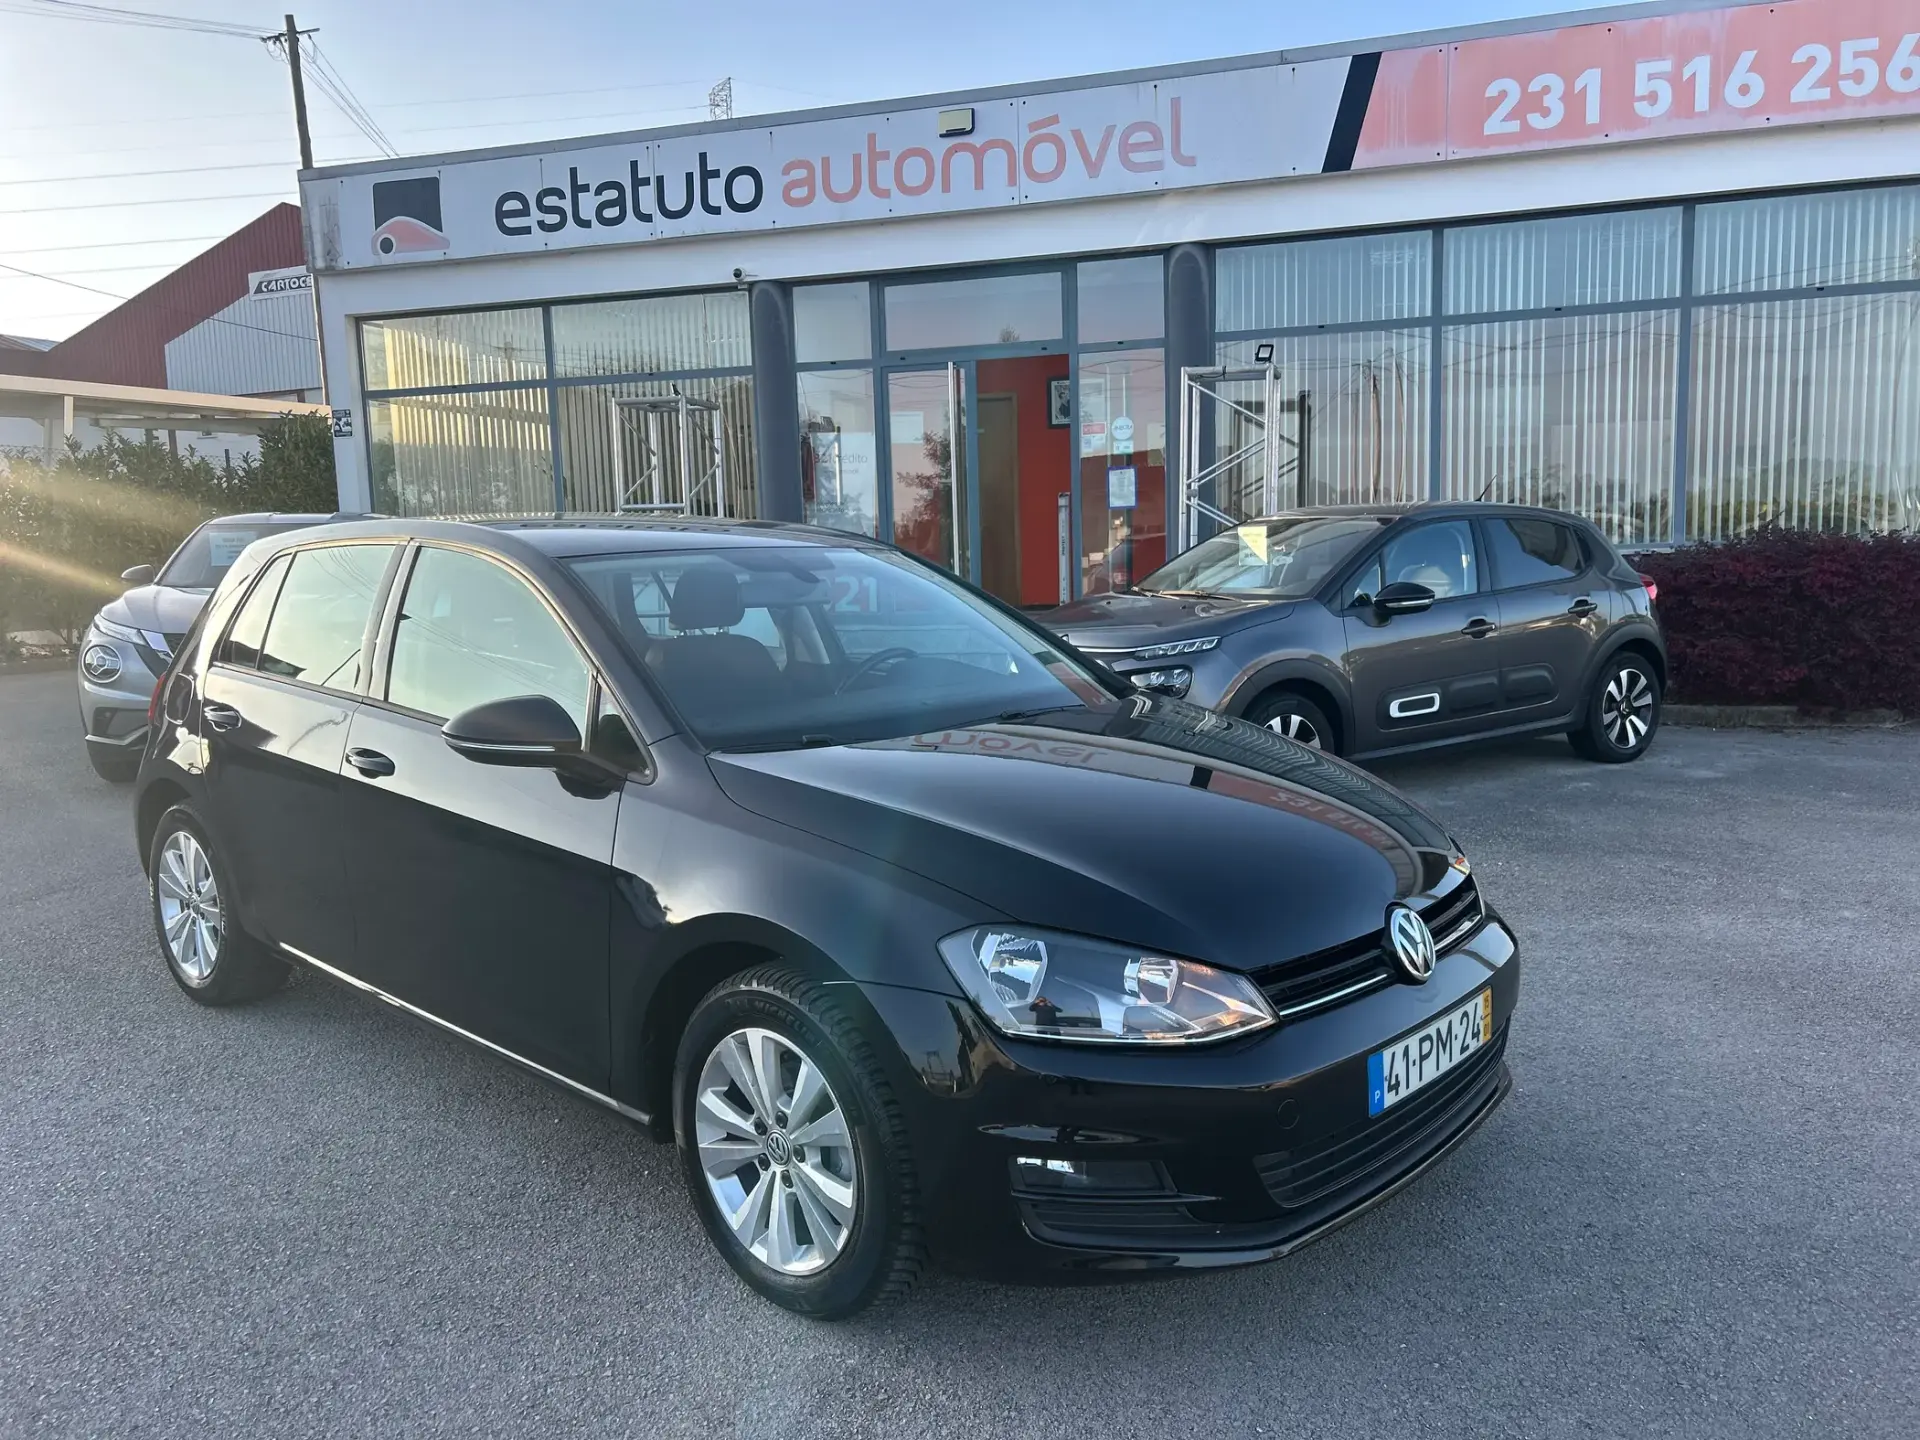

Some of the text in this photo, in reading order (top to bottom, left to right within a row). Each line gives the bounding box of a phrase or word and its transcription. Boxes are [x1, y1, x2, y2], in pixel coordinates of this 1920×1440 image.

[1483, 33, 1920, 135] 231 516 256
[495, 96, 1197, 236] estatuto automóvel
[822, 574, 878, 613] 21
